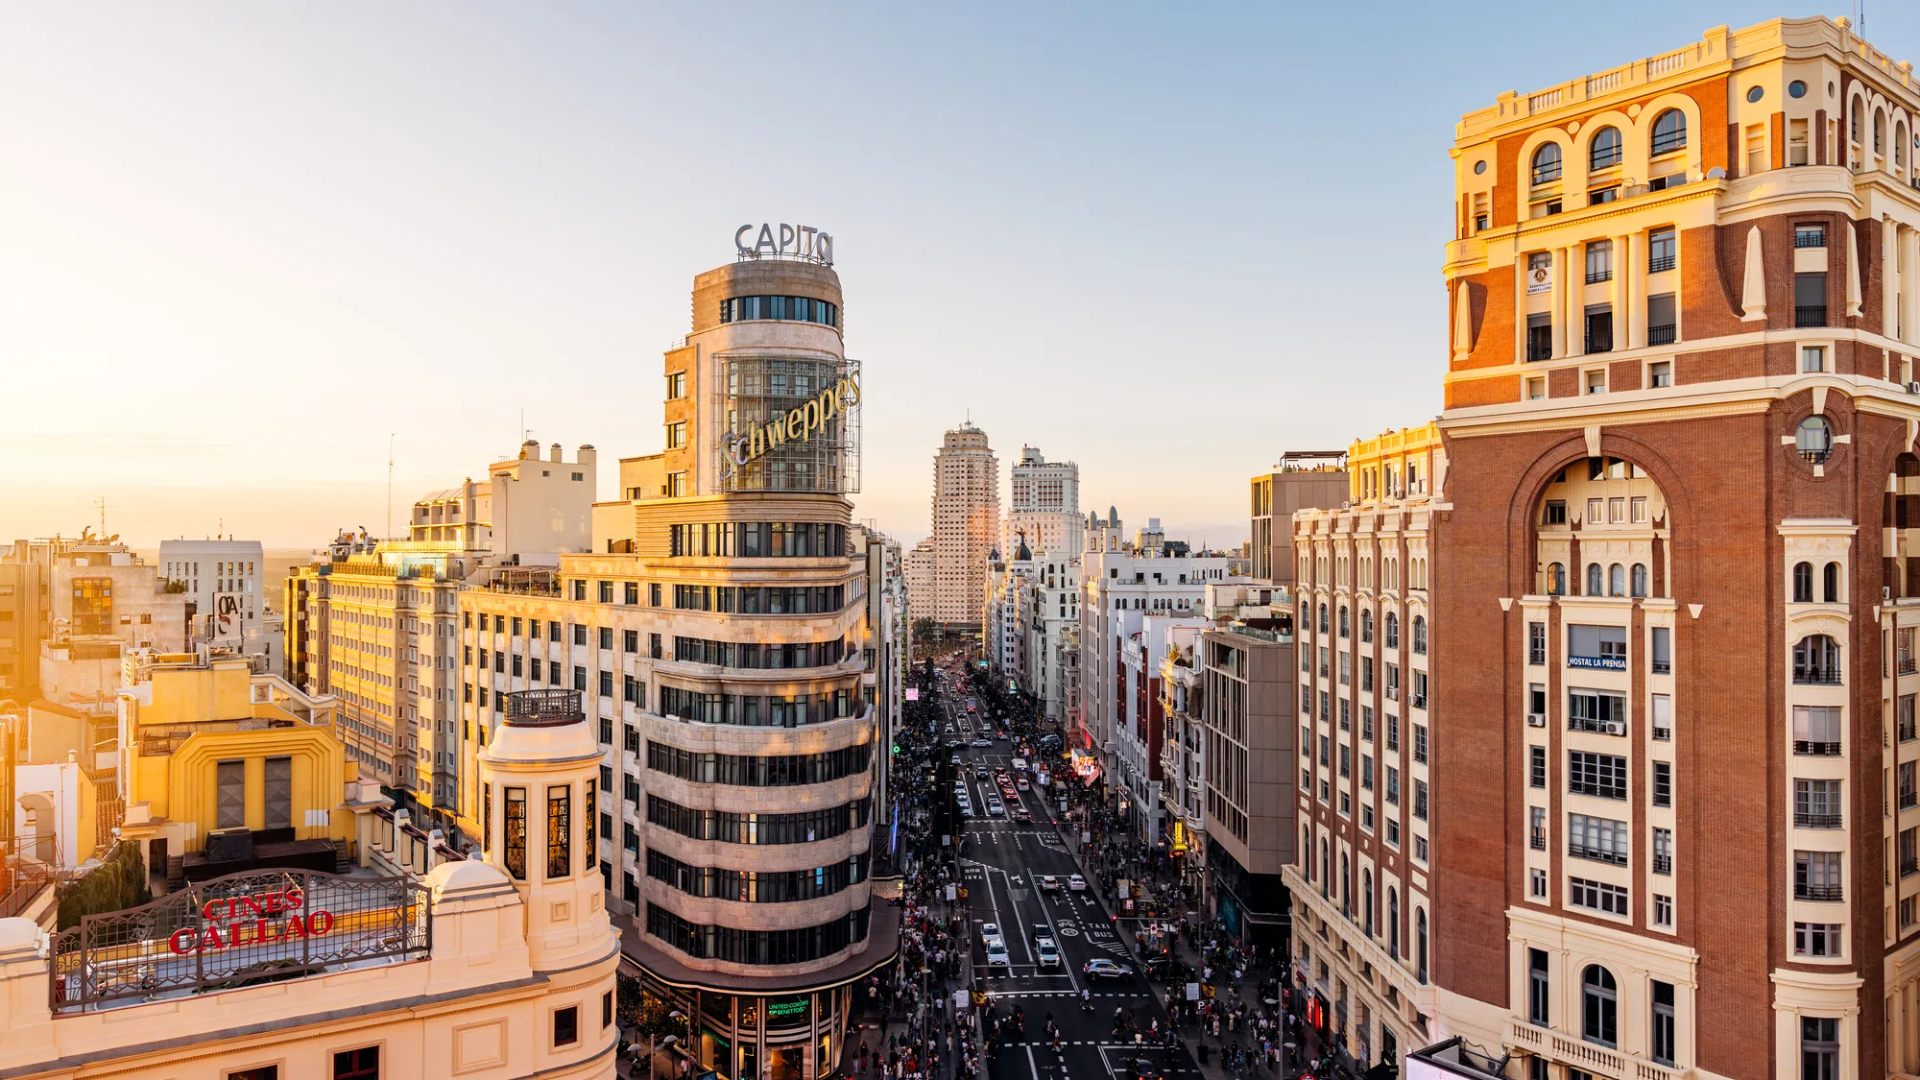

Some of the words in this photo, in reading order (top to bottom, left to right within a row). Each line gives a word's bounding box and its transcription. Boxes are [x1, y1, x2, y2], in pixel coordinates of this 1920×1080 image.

[719, 369, 860, 480] Schweppes
[1569, 657, 1592, 666] HOSTAL
[1602, 660, 1626, 668] PRENSA
[203, 890, 303, 920] CINES
[169, 910, 334, 955] CALLAO
[789, 1000, 809, 1008] COLORS
